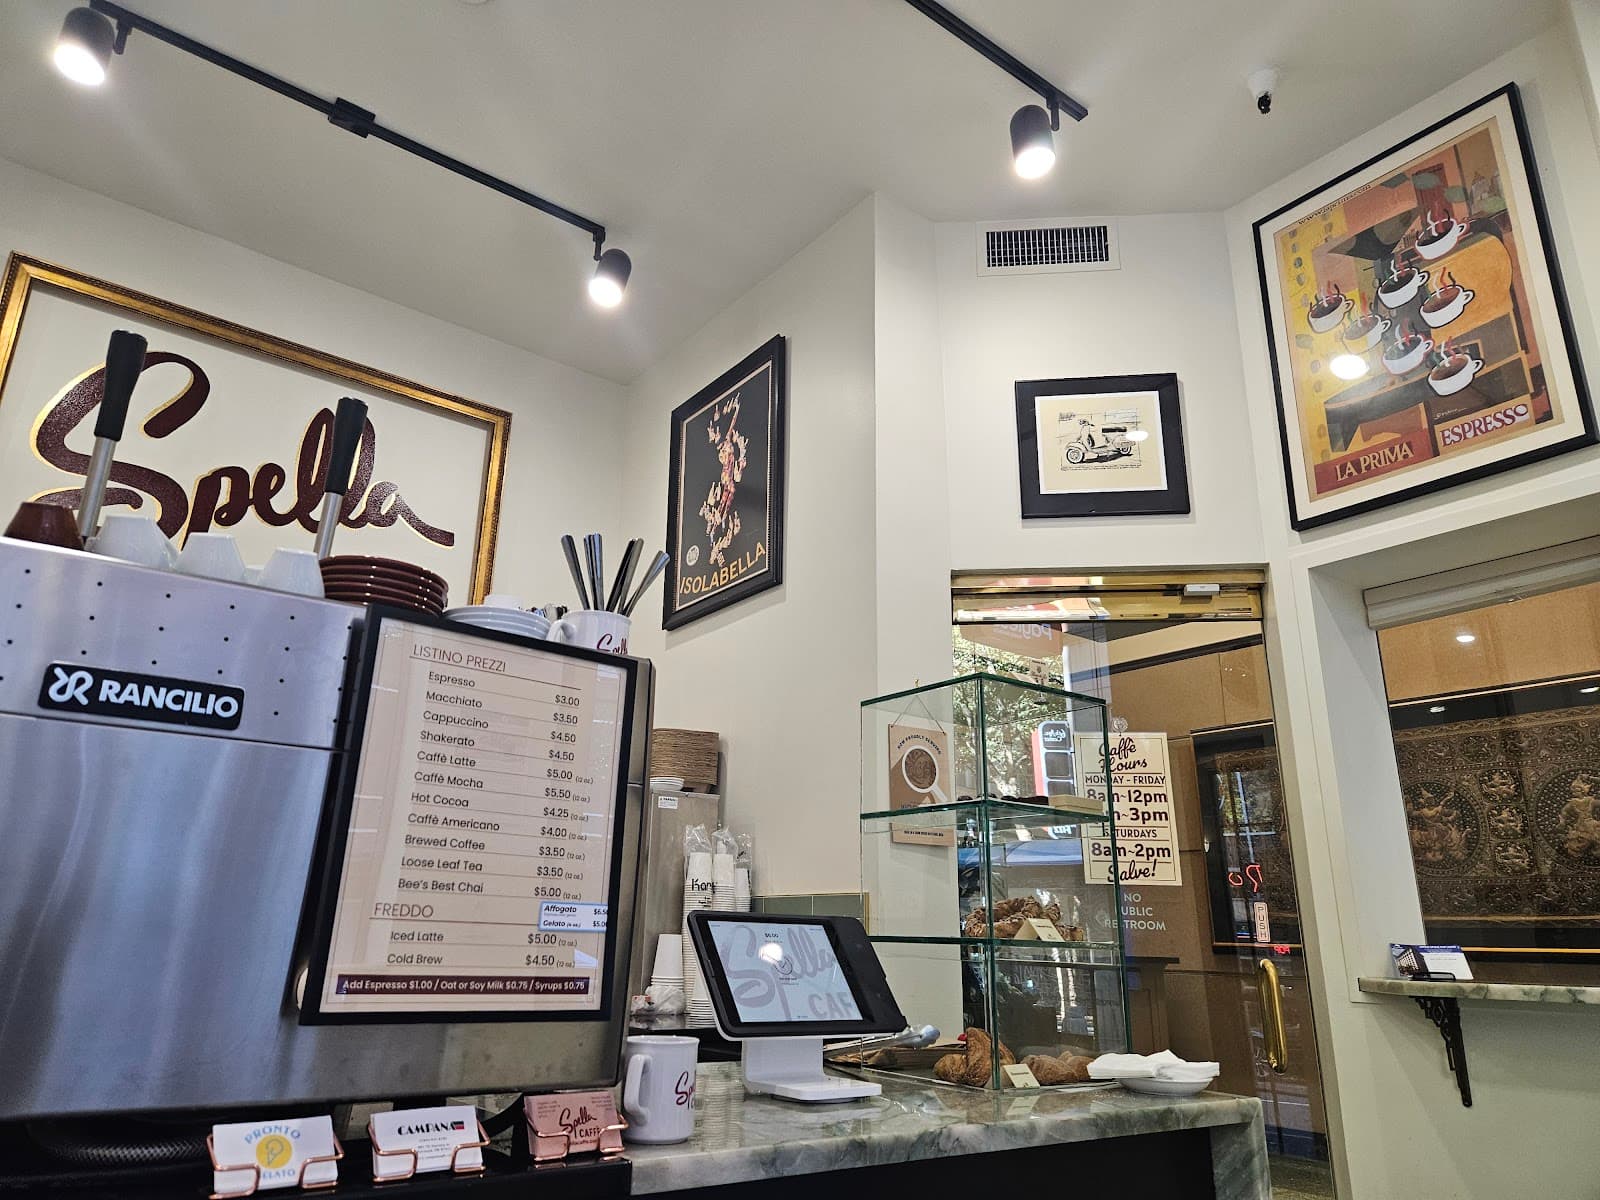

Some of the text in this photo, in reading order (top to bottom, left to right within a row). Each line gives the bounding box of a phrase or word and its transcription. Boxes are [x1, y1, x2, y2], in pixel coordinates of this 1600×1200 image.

[1440, 404, 1529, 447] ESPRESSO
[30, 350, 455, 552] Spella
[1336, 441, 1414, 481] LA PRIMA
[680, 542, 766, 595] ISOLABELLA
[413, 644, 506, 672] LISTINO PREZZI
[99, 679, 239, 719] RANCILIO
[428, 671, 580, 706] Espresso $3.00
[426, 691, 578, 724] Macchiato $3.50
[423, 710, 576, 743] Cappuccino $4.50
[420, 730, 575, 761] Shakerato $4.50
[417, 751, 447, 763] Caffè
[449, 755, 476, 767] Latte
[547, 768, 573, 780] $5.00
[414, 771, 444, 784] Caffè
[447, 775, 484, 789] Mocha
[544, 787, 571, 799] $5.50
[1085, 775, 1124, 784] MONAY
[1133, 775, 1166, 785] FRIDAY
[411, 792, 430, 803] Hot
[433, 794, 469, 807] Cocoa
[543, 806, 569, 818] $4.25
[408, 813, 439, 825] Caffè
[441, 817, 500, 831] Americano
[540, 826, 567, 837] $4.00
[405, 834, 447, 847] Brewed
[450, 838, 485, 850] Coffee
[539, 846, 565, 857] $3.50
[401, 856, 434, 868] Loose
[437, 859, 460, 870] Leaf
[464, 860, 483, 871] Tea
[536, 866, 564, 877] $3.50
[398, 878, 428, 890] Bee's
[431, 880, 455, 891] Best
[458, 882, 484, 893] Chai
[534, 886, 562, 898] $5.00
[1123, 893, 1142, 902] NO
[374, 902, 434, 918] FREDDO
[544, 904, 577, 913] Affogato
[1120, 906, 1153, 917] UBLIC
[543, 919, 566, 927] Gelato
[1104, 919, 1166, 931] RETROOM
[390, 931, 415, 941] Iced
[417, 931, 444, 942] Latte
[527, 933, 557, 945] $5.00
[387, 953, 414, 964] Cold
[416, 954, 443, 965] Brew
[525, 954, 555, 966] $4.50
[342, 980, 363, 989] Add
[364, 980, 408, 992] Espresso
[409, 980, 433, 990] $1.00
[440, 981, 457, 990] Oat
[458, 982, 468, 990] or
[469, 981, 485, 992] Soy
[486, 980, 503, 990] Milk
[505, 980, 528, 990] $0.75
[535, 981, 563, 992] Syrups
[563, 981, 585, 990] $0.75
[244, 1124, 301, 1145] PRONTO
[397, 1121, 456, 1136] CAMPANA
[559, 1106, 598, 1140] Spella
[261, 1168, 296, 1179] ELATO
